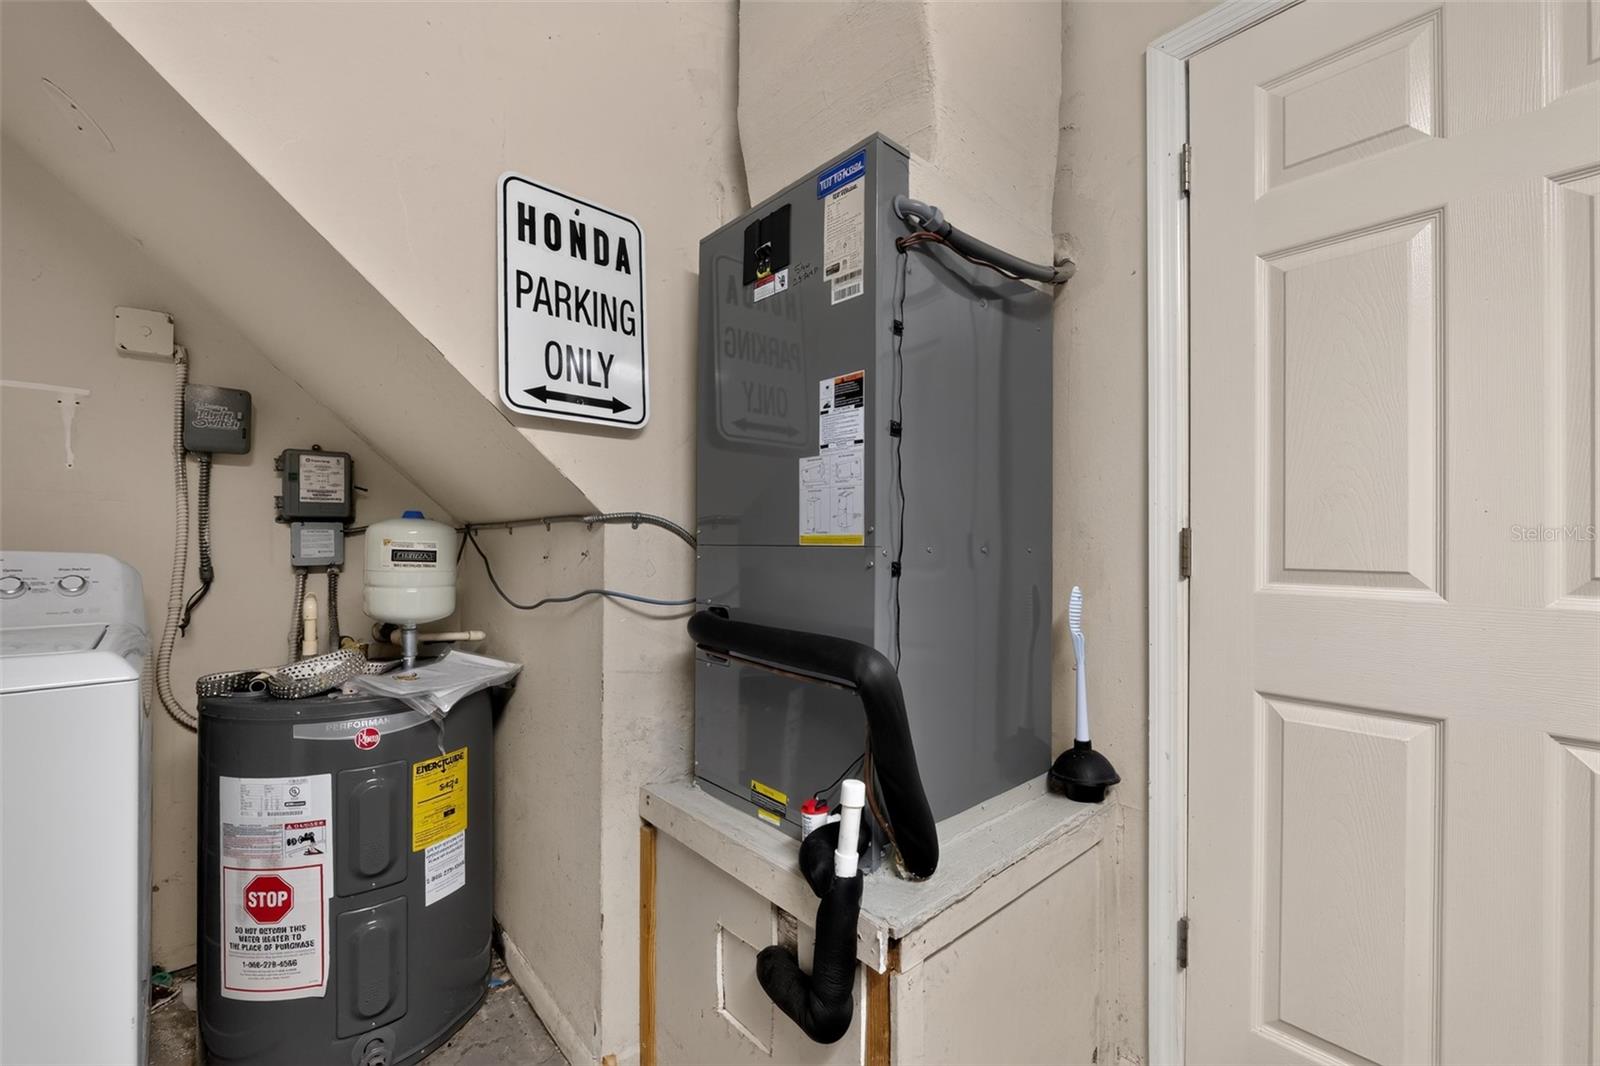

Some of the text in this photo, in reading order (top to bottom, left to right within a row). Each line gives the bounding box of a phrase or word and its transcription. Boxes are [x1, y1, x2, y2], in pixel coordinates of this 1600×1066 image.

[517, 200, 631, 275] HONDA
[515, 269, 636, 337] PARKING
[544, 340, 615, 389] ONLY
[248, 891, 288, 908] STOP
[235, 926, 243, 934] DO
[290, 924, 307, 933] THIS
[292, 933, 302, 941] TO
[229, 942, 240, 950] THE
[241, 943, 262, 952] PLACE
